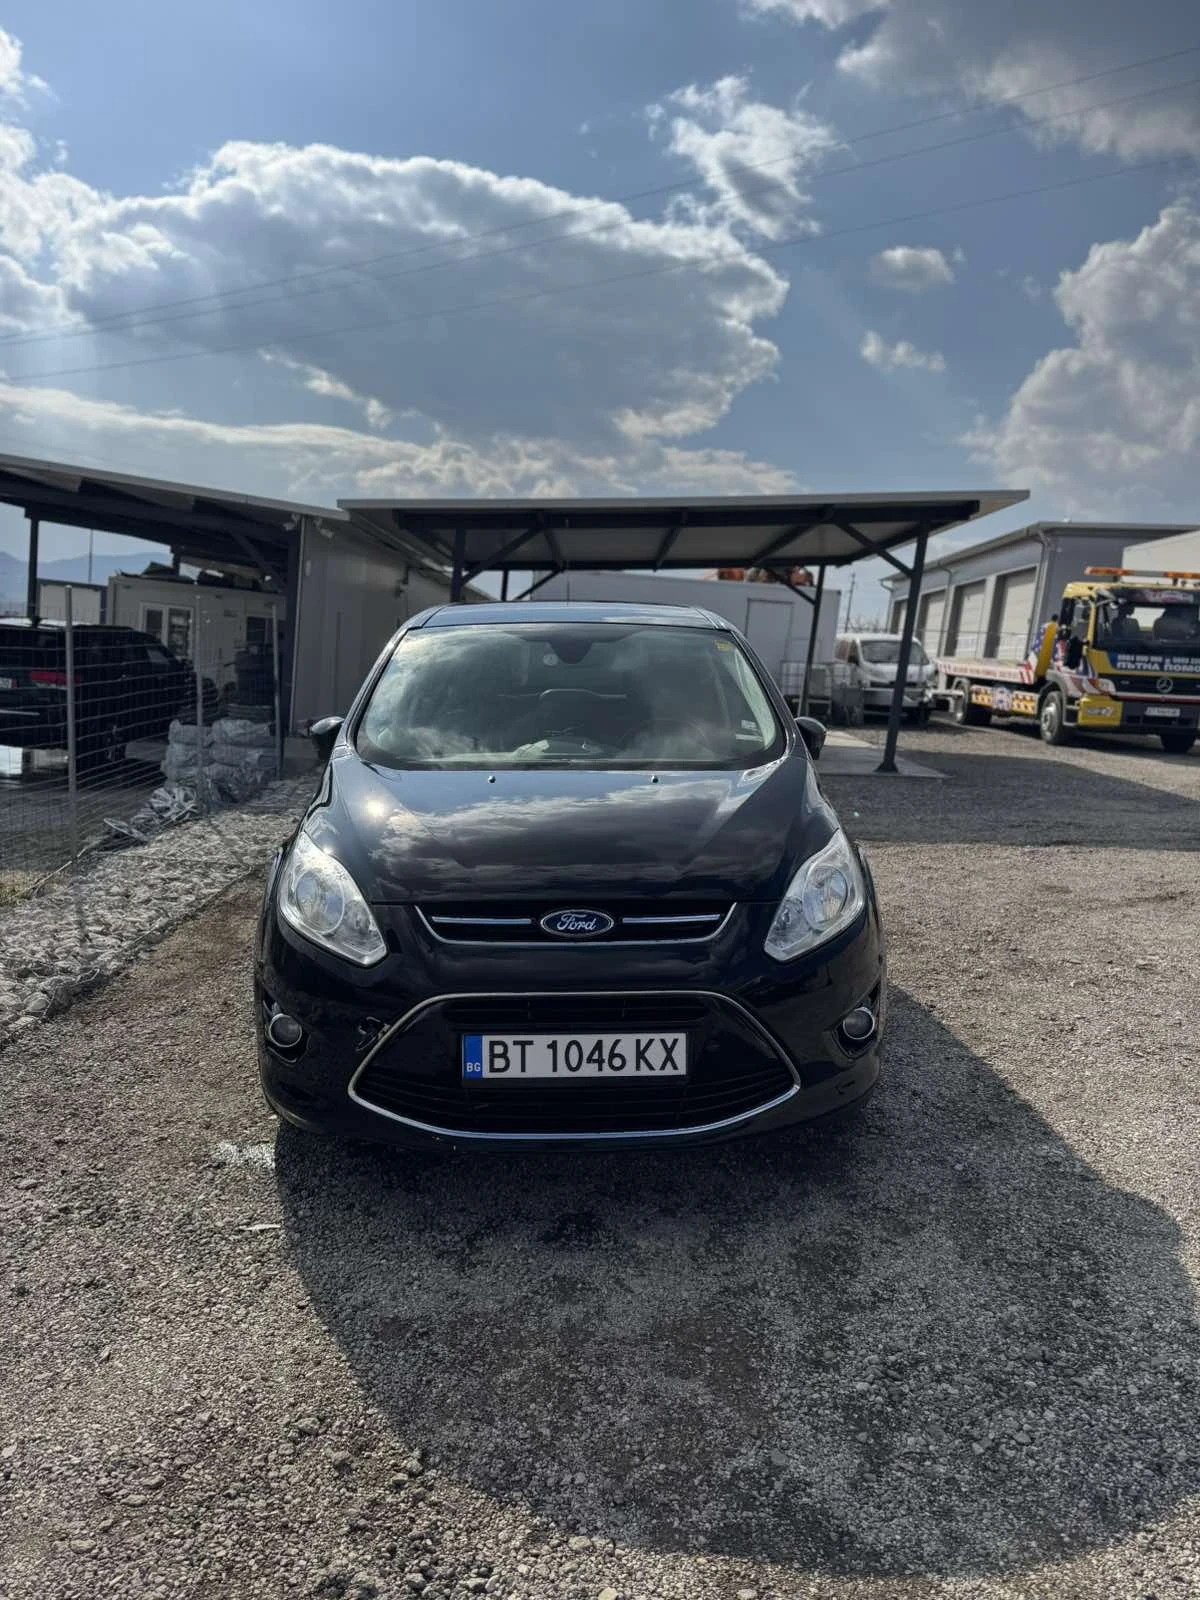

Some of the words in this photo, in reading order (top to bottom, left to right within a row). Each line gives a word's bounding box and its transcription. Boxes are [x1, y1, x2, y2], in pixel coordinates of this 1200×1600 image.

[556, 913, 597, 932] Ford
[488, 1040, 534, 1074] BT
[546, 1038, 627, 1073] 1046
[635, 1038, 679, 1072] KX
[466, 1062, 481, 1073] BG
